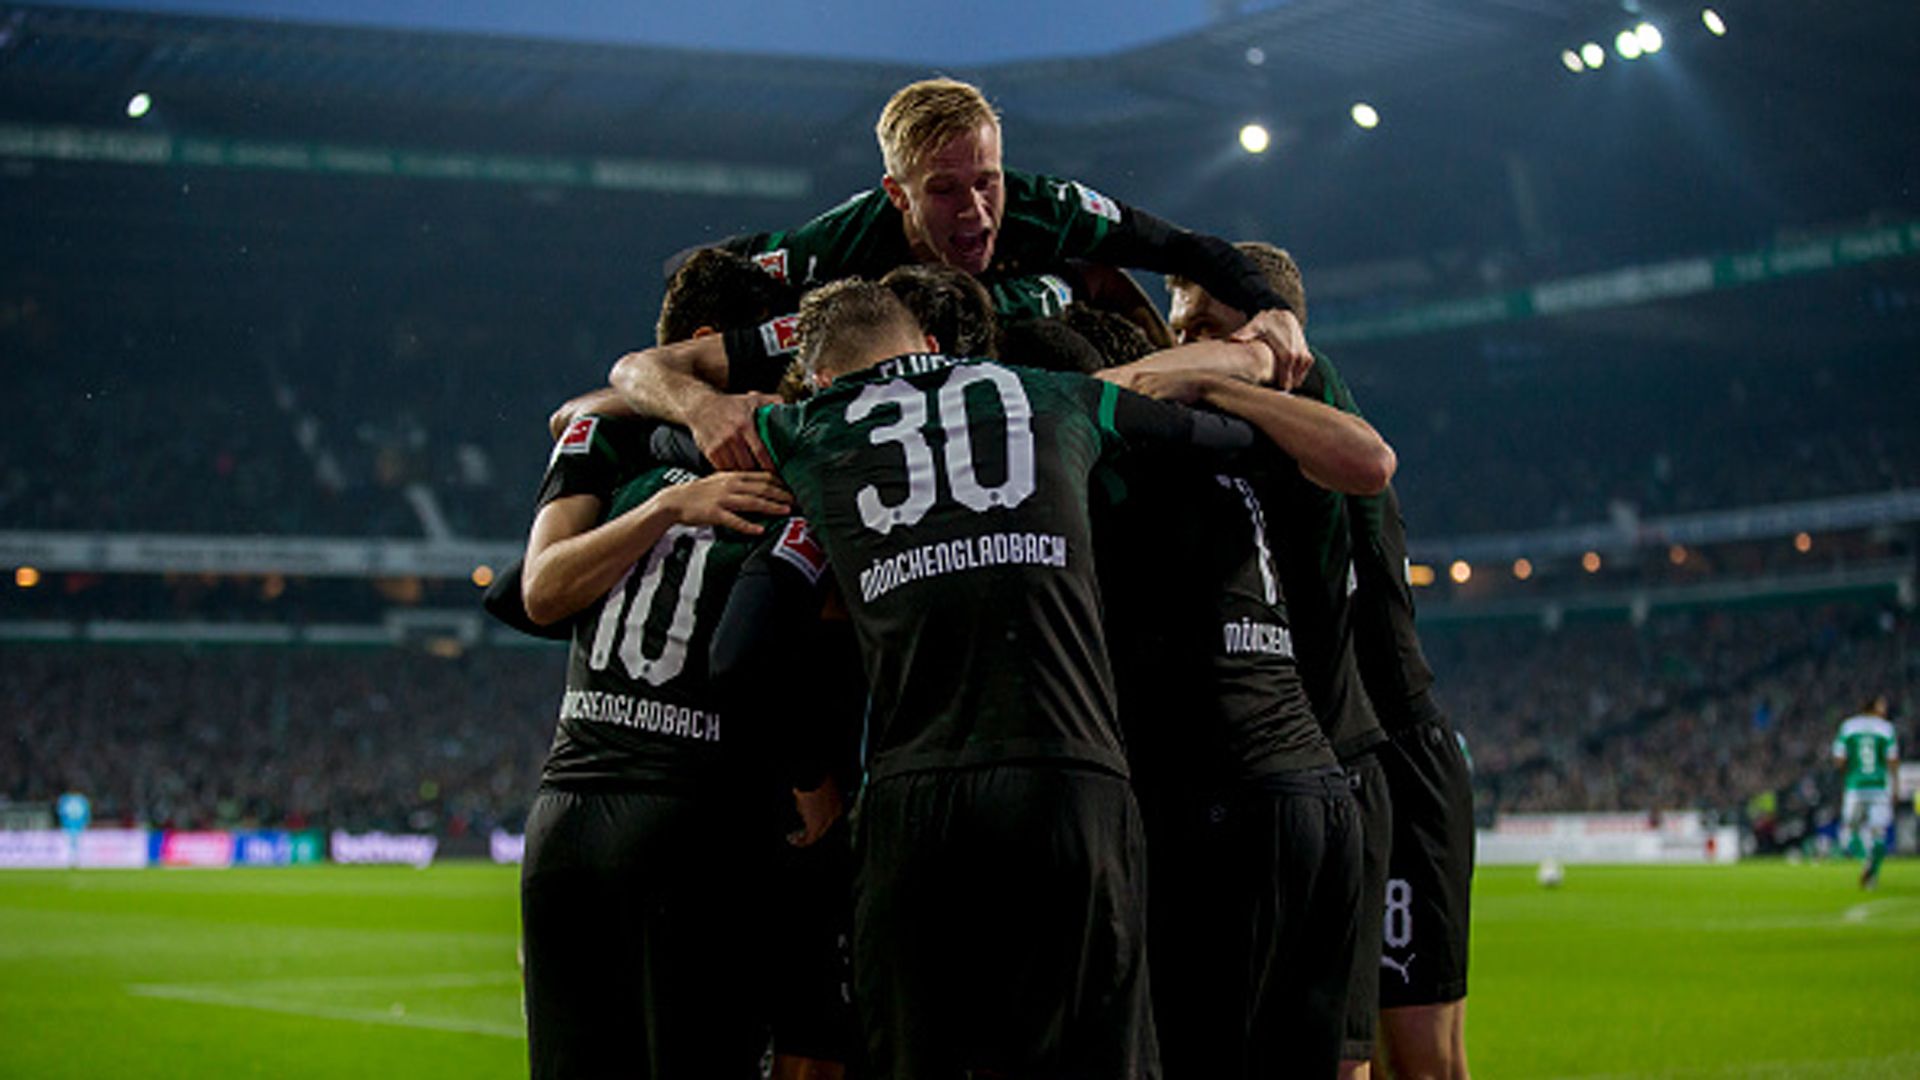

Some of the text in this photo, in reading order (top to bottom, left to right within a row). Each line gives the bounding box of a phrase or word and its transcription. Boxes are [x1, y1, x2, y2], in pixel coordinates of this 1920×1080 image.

[844, 361, 1035, 535] 30
[590, 524, 716, 686] 10
[860, 533, 1067, 602] MÖNCHENGLADBACH
[1384, 879, 1412, 948] 8
